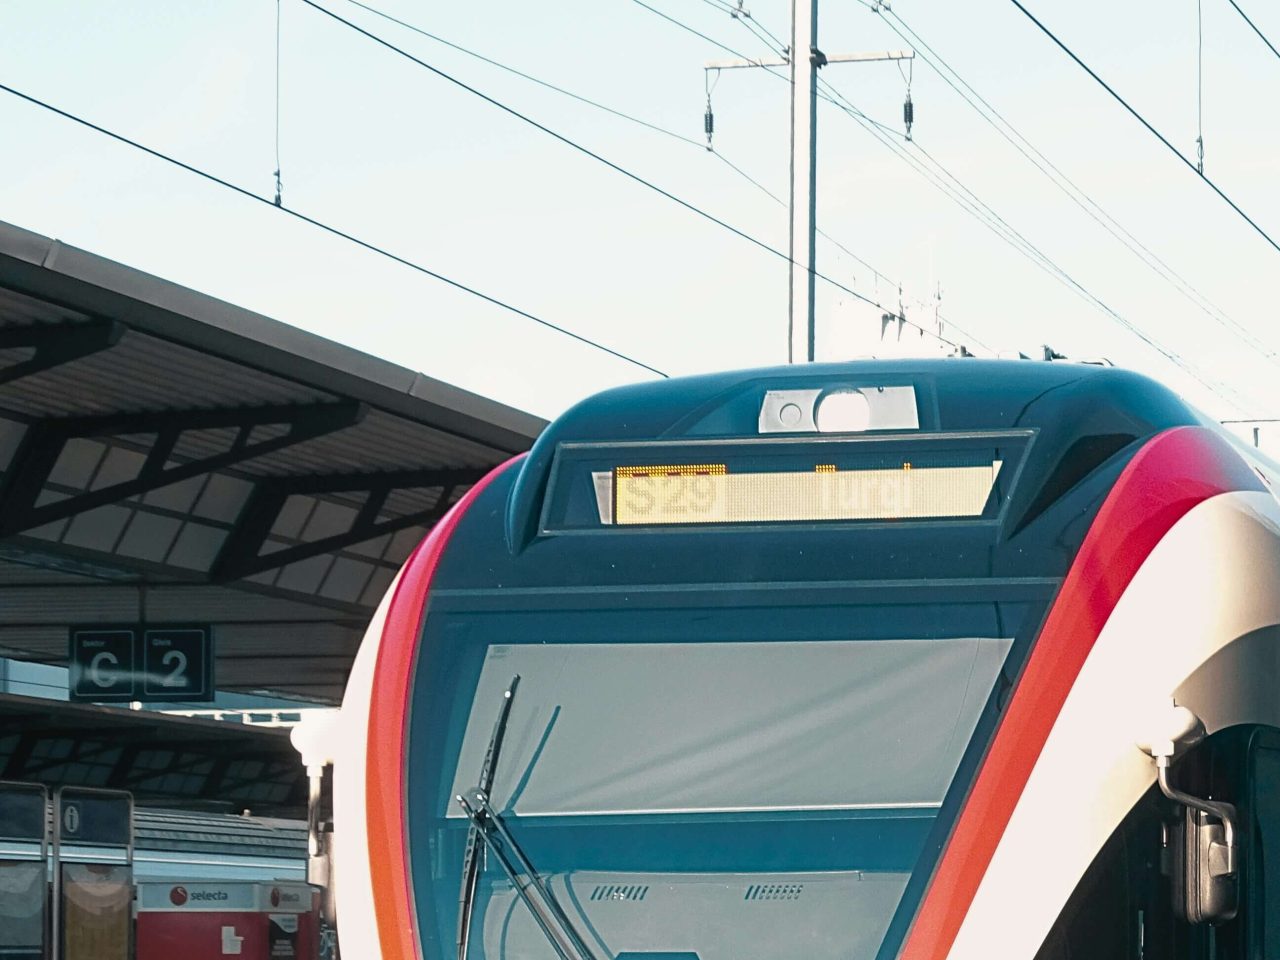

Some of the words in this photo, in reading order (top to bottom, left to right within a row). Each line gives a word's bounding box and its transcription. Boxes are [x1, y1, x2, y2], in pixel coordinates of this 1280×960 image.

[624, 471, 717, 514] S29
[91, 651, 118, 687] C
[162, 650, 187, 687] 2
[190, 891, 228, 901] selecta
